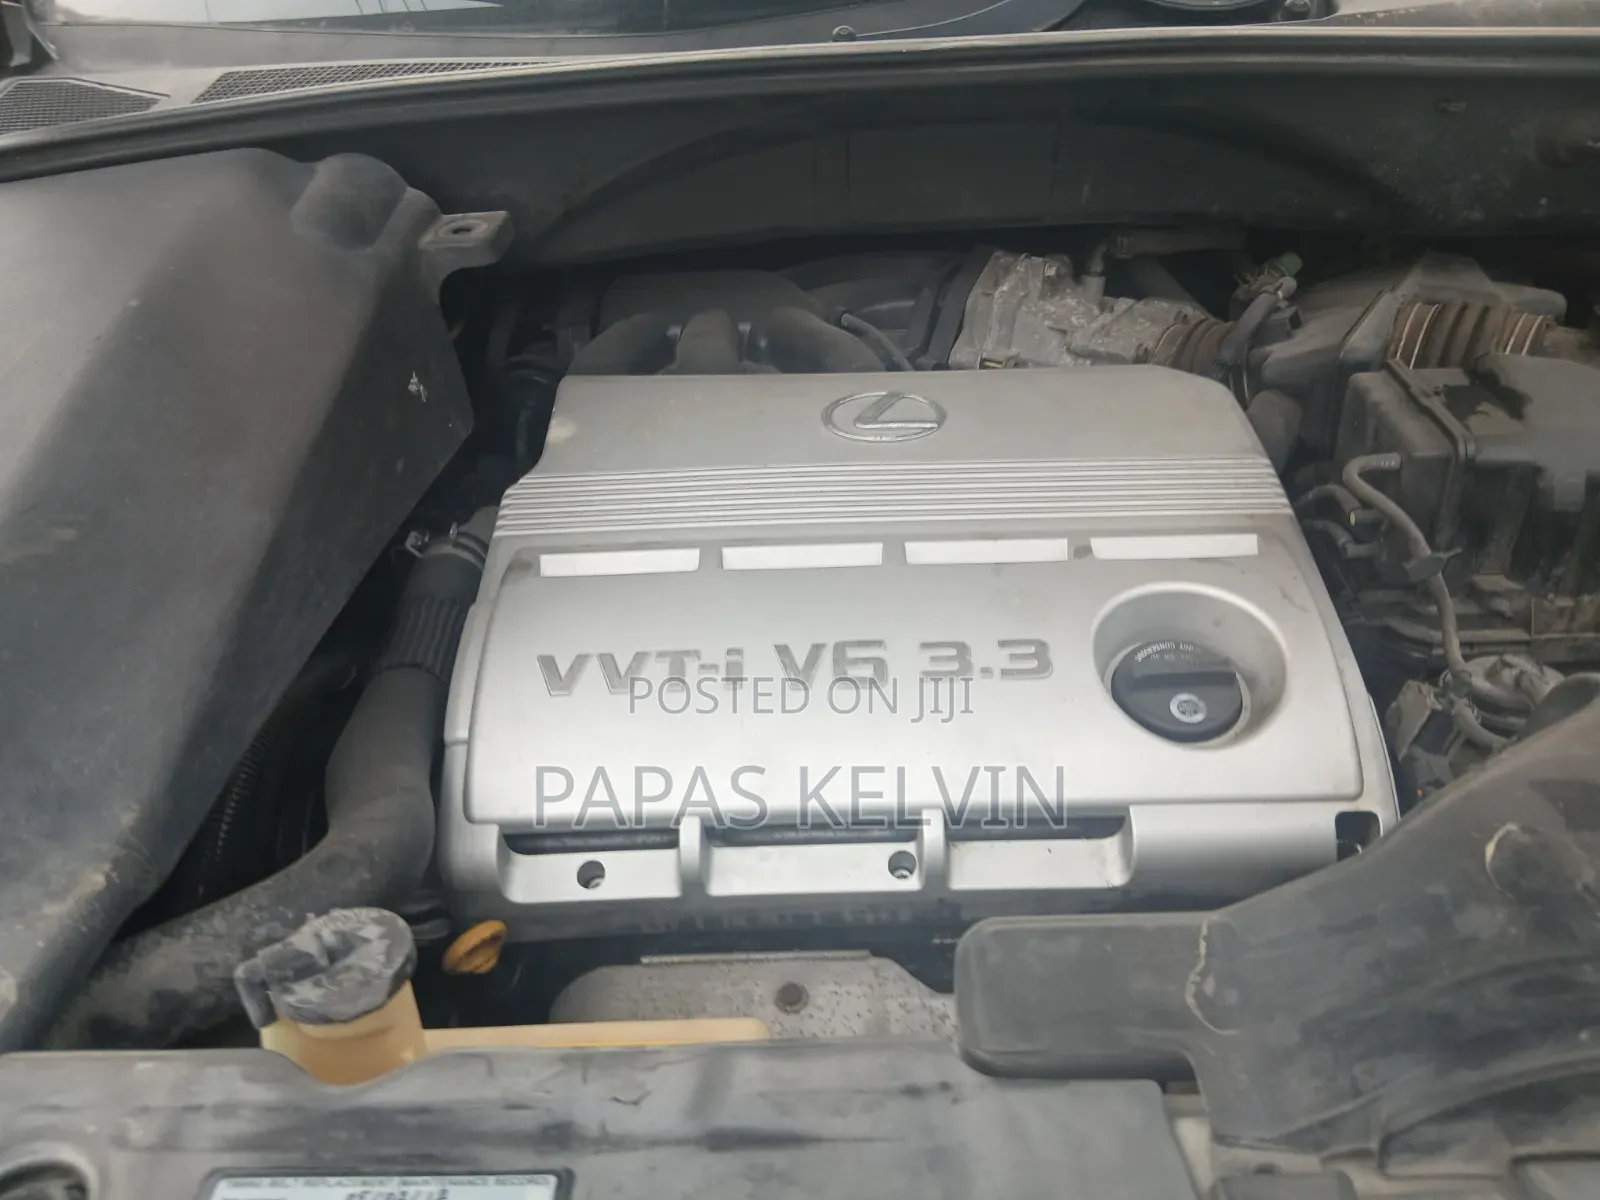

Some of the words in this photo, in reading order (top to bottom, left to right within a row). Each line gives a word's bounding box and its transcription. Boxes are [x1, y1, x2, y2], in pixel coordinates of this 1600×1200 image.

[536, 647, 744, 697] VVT-i
[773, 639, 888, 692] V6
[918, 638, 1053, 681] 3.3
